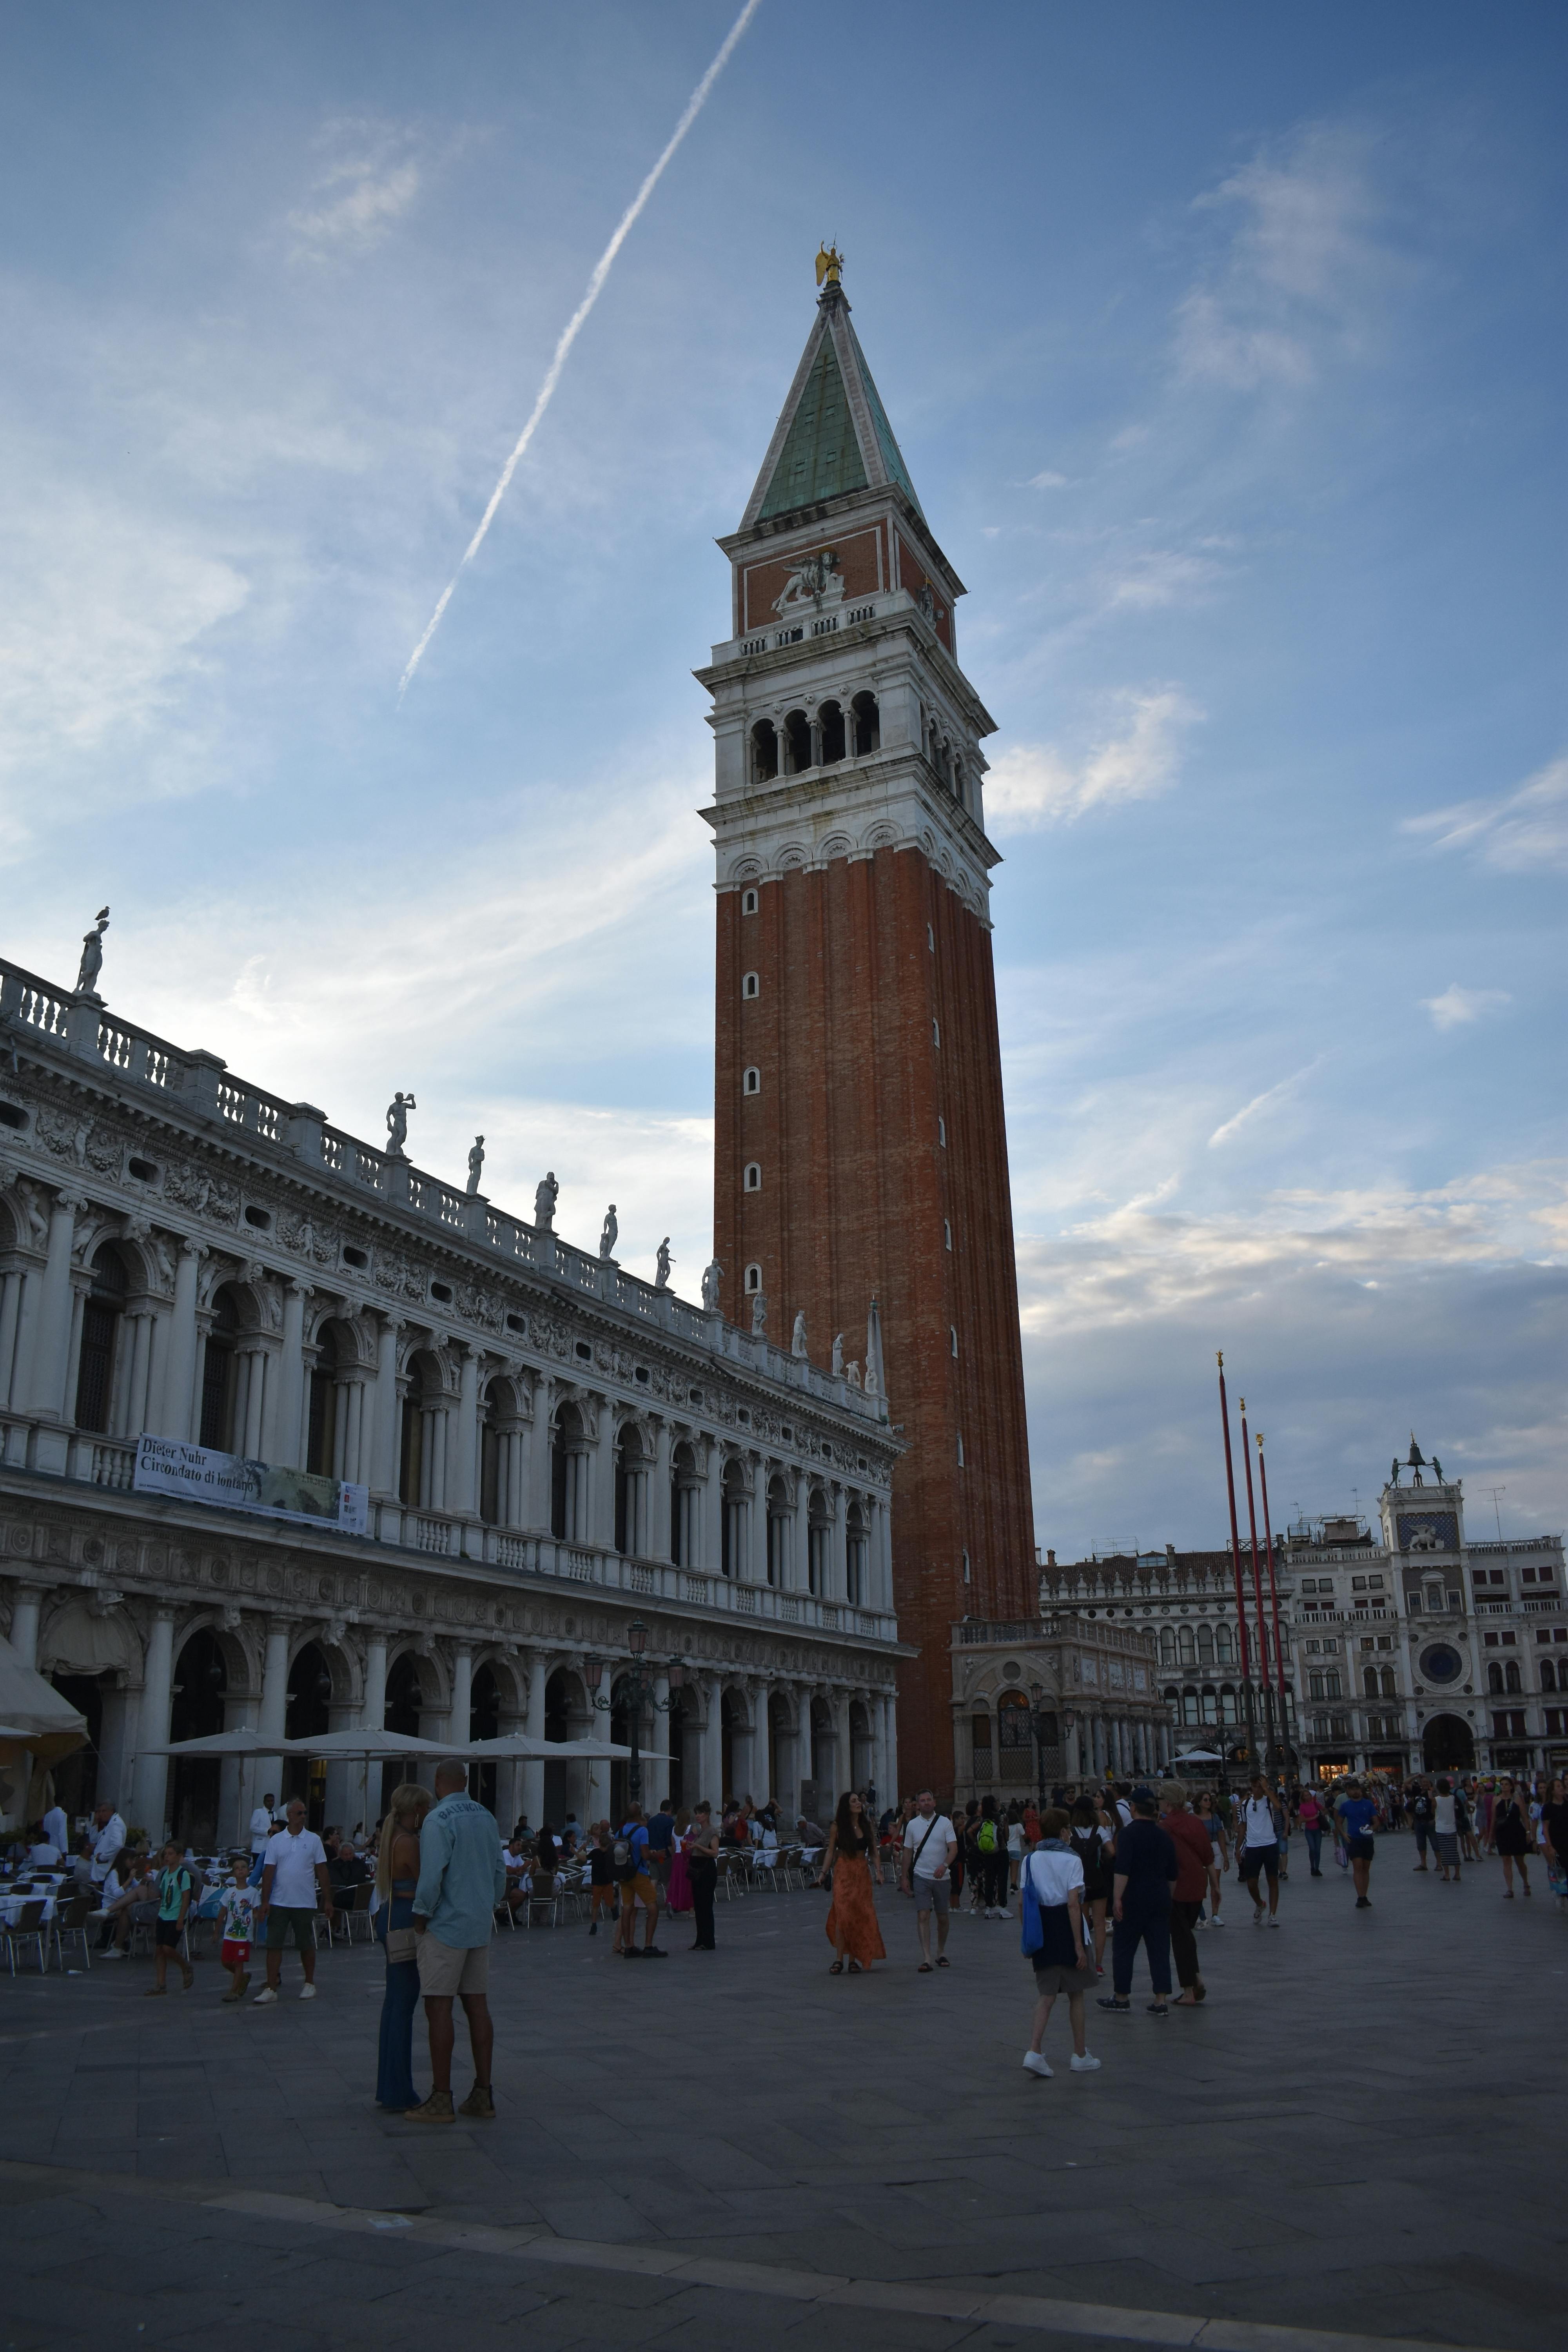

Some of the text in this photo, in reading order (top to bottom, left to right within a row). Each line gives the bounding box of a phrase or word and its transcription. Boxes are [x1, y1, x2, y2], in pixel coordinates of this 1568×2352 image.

[143, 1439, 207, 1466] Dieter Nuhr
[141, 1456, 254, 1492] Circondato di lontano
[438, 1803, 487, 1820] BALENCIA
